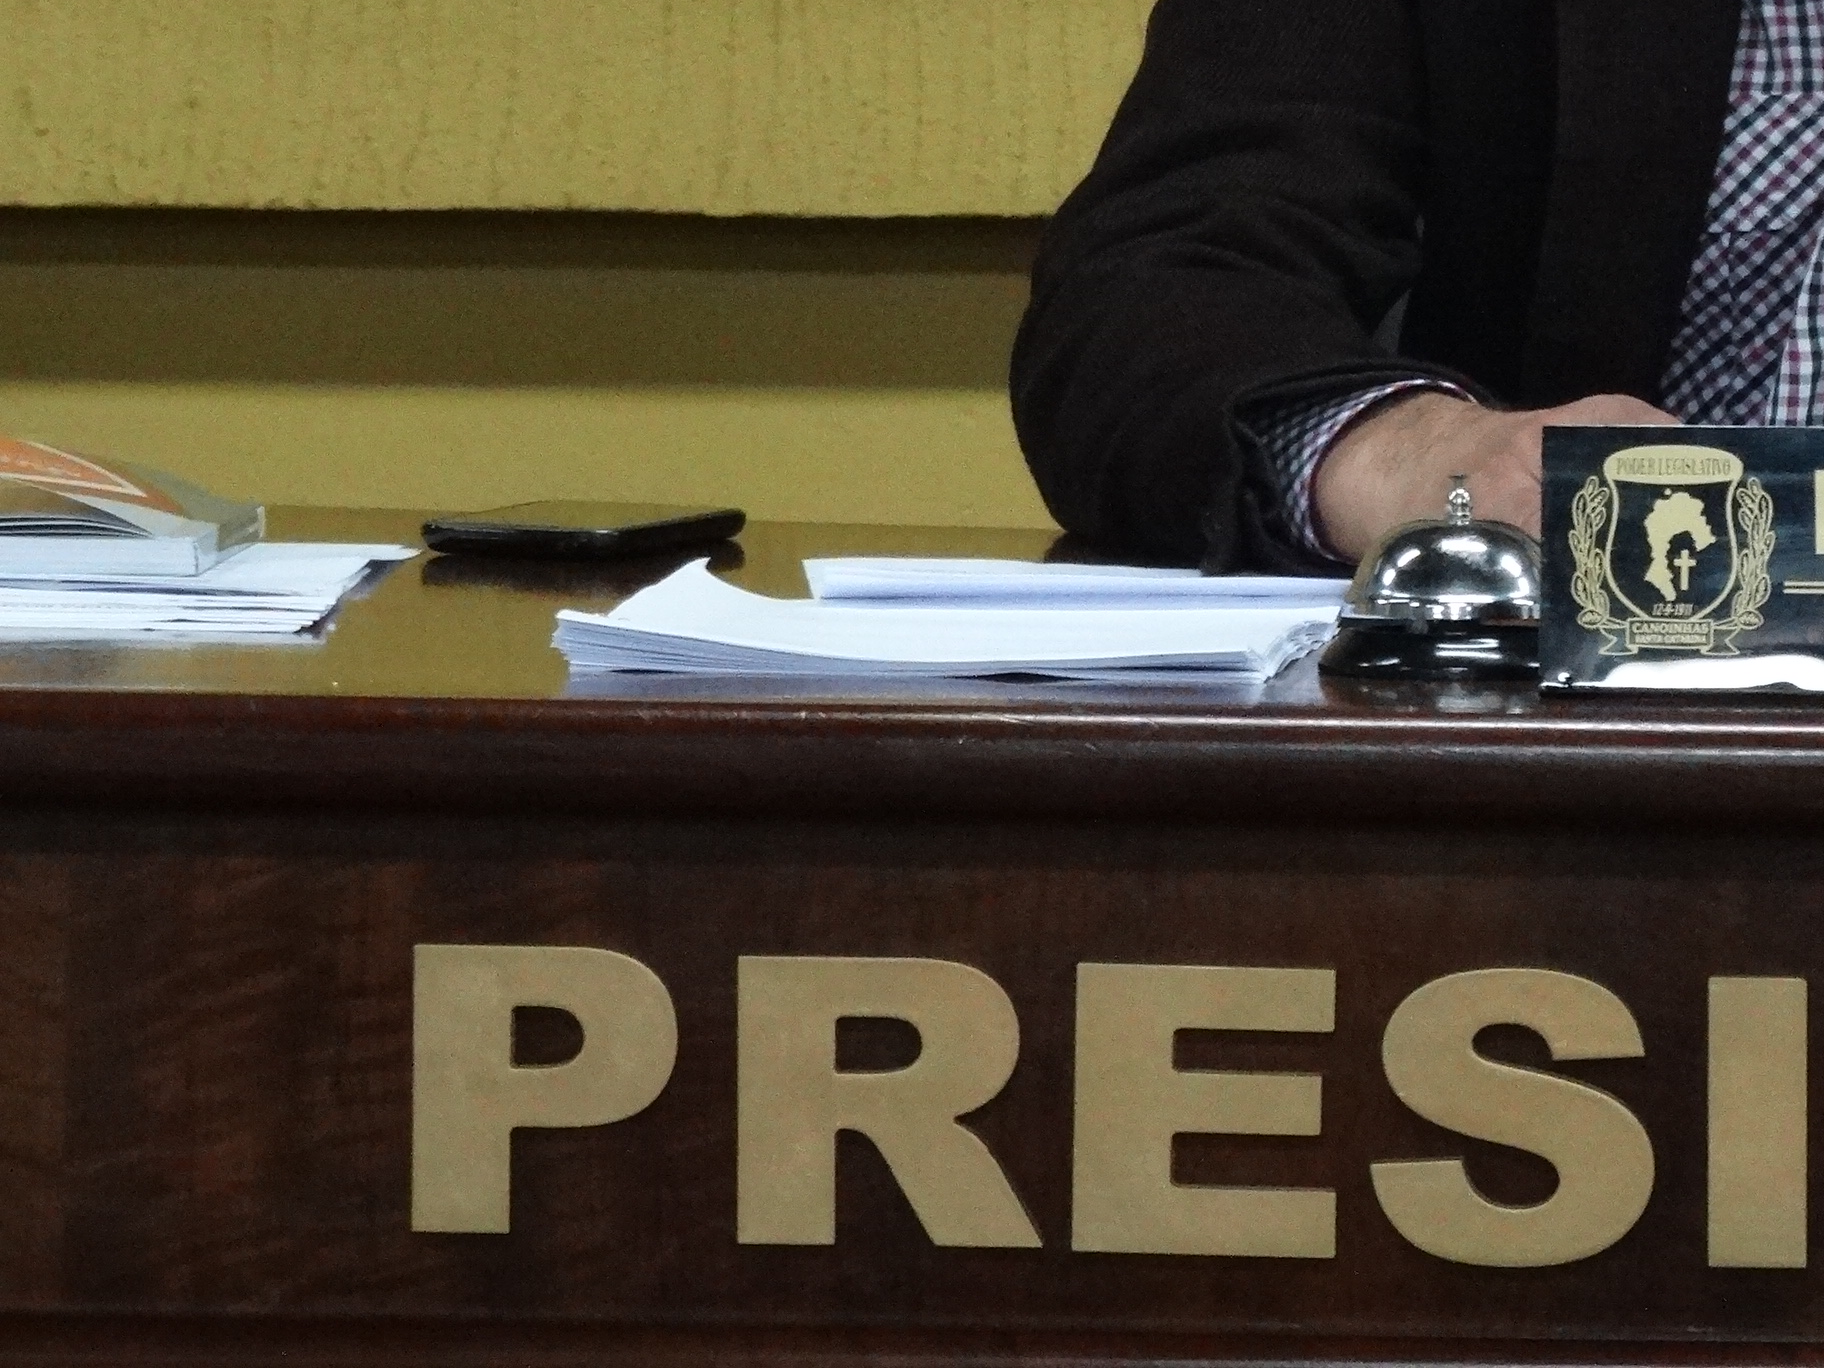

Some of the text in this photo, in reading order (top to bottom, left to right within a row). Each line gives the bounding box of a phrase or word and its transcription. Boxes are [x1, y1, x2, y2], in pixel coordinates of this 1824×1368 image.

[1616, 457, 1731, 476] PODER LEGISLATIVO
[1631, 622, 1709, 634] CANOINHAS
